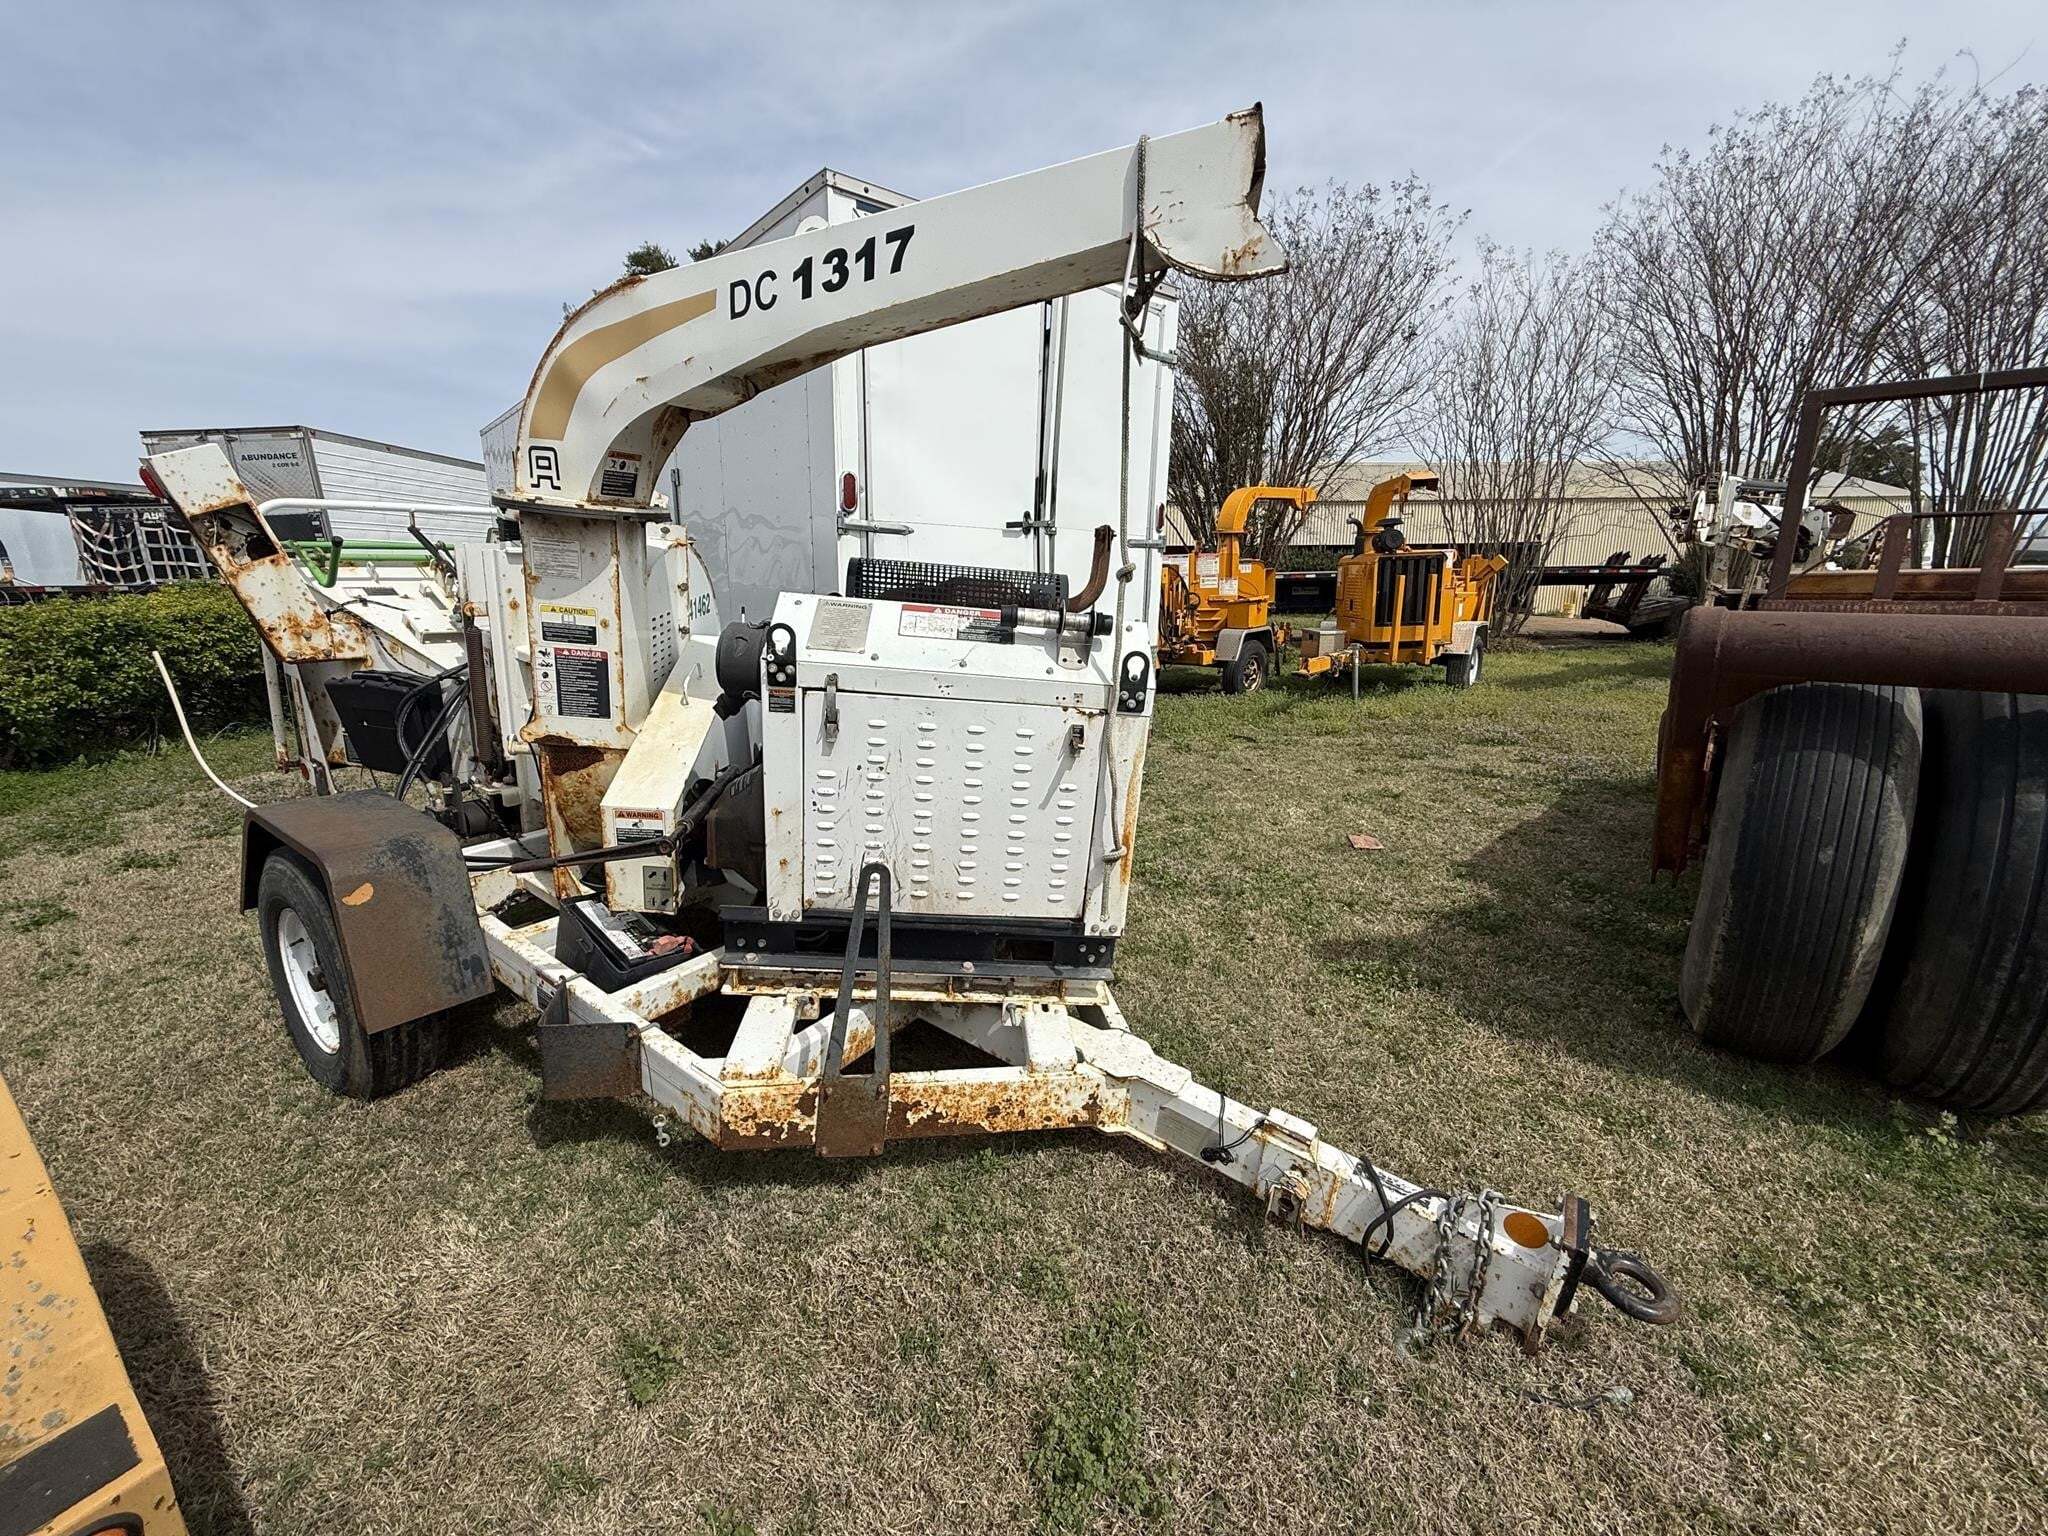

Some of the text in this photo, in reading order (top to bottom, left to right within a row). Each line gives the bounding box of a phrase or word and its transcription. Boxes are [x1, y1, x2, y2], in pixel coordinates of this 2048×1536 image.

[730, 224, 915, 320] DC 1317
[241, 452, 298, 461] ABUNDANCE
[830, 601, 868, 610] WARNING
[558, 607, 588, 616] CAUTION
[944, 608, 981, 617] DANGER
[570, 649, 602, 658] DANGER
[626, 811, 660, 820] WARNING
